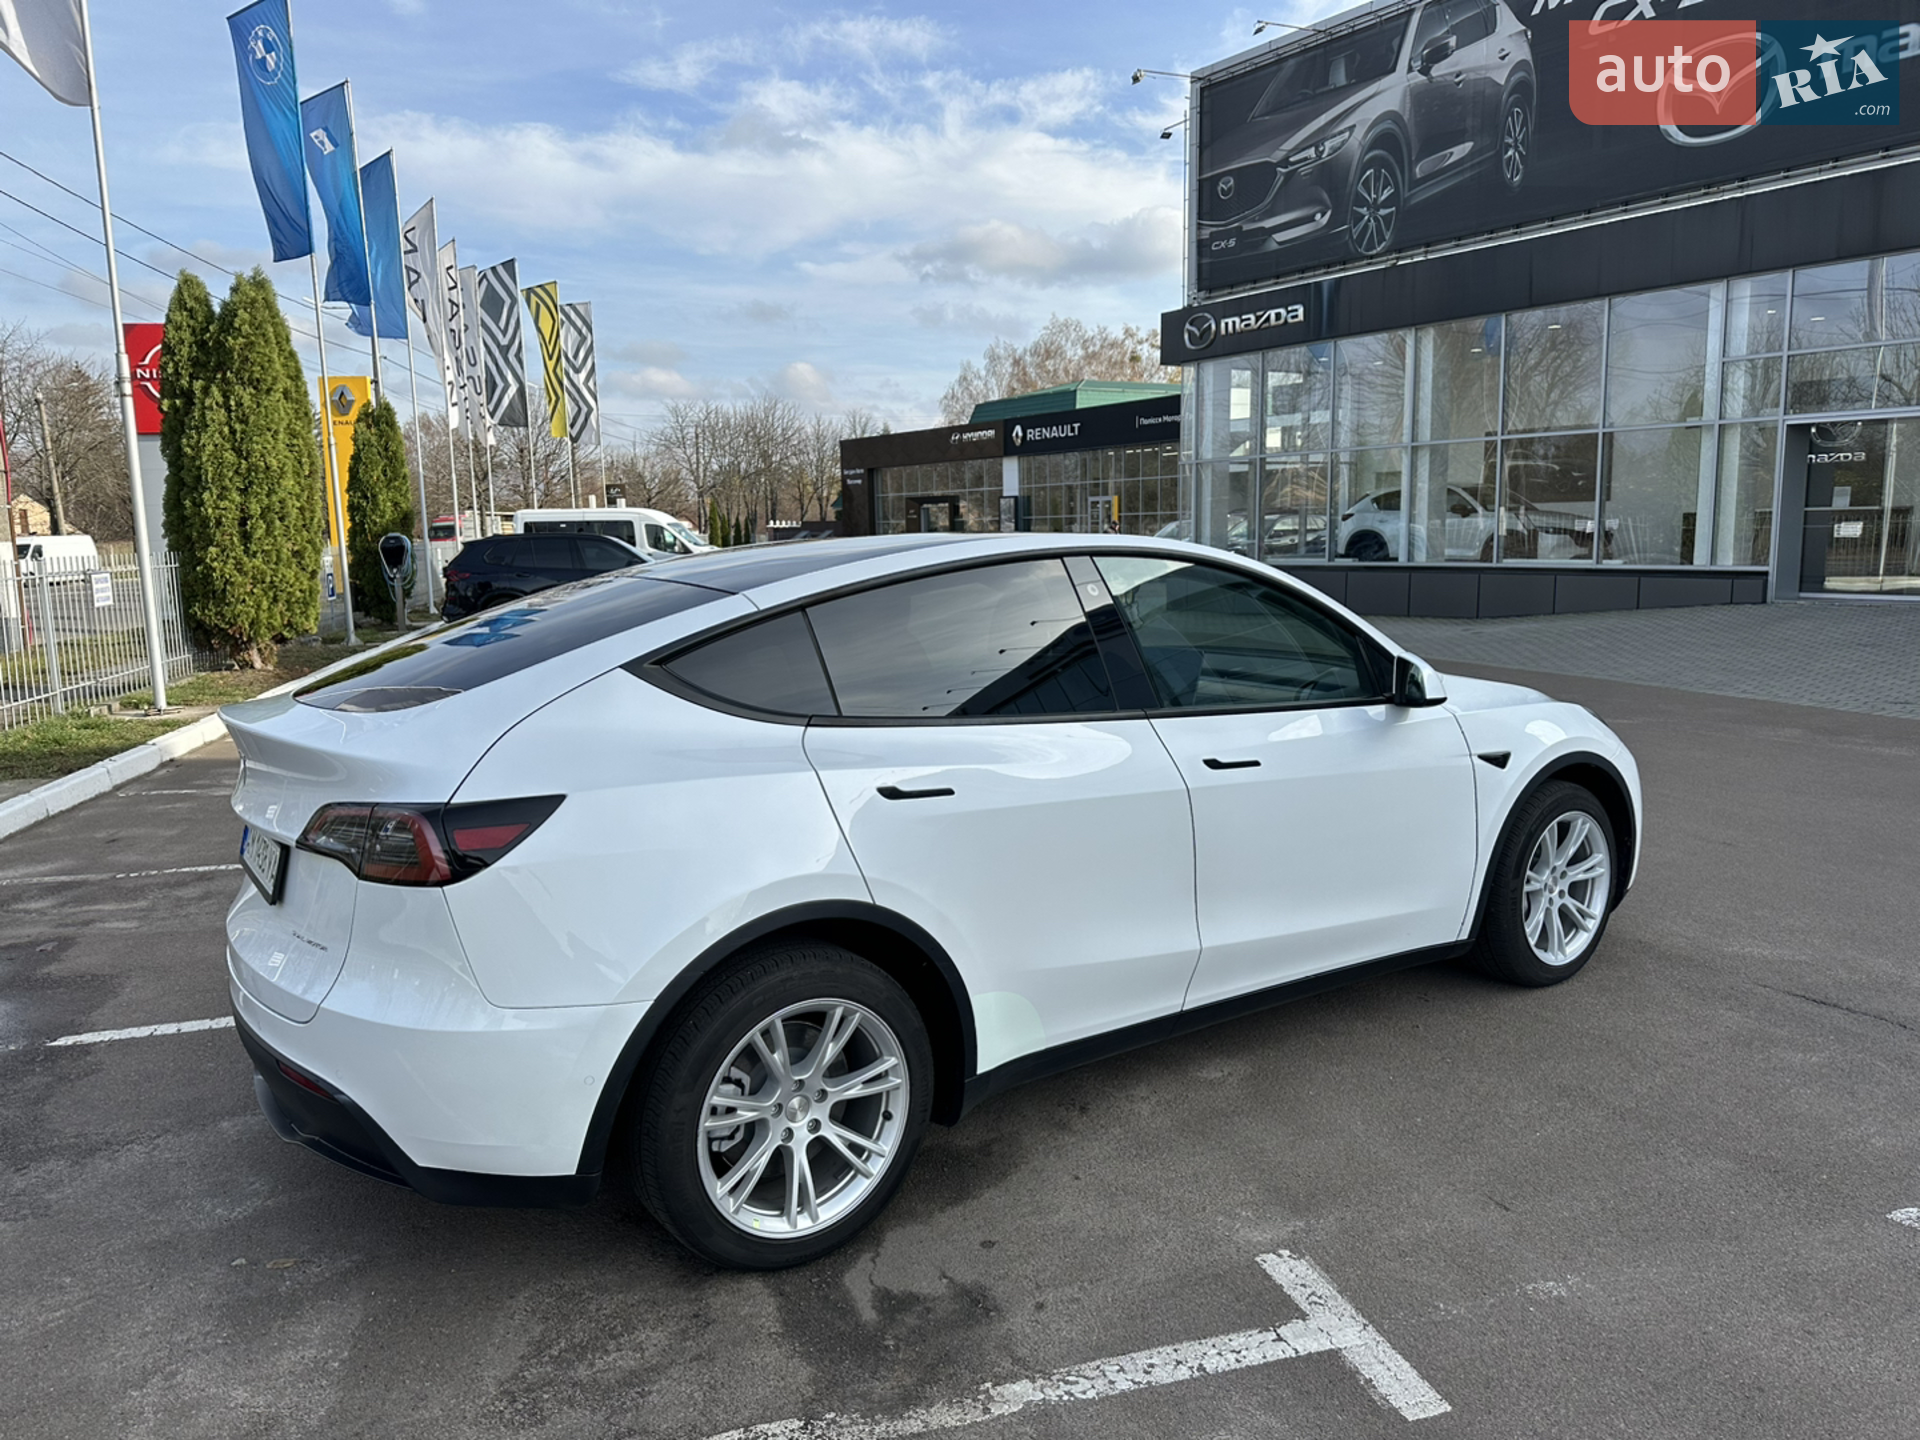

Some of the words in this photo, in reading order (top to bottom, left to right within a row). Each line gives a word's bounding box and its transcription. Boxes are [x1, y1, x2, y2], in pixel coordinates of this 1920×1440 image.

[1211, 237, 1237, 251] CX-5
[1220, 303, 1305, 336] mazda
[1026, 423, 1081, 441] RENAULT
